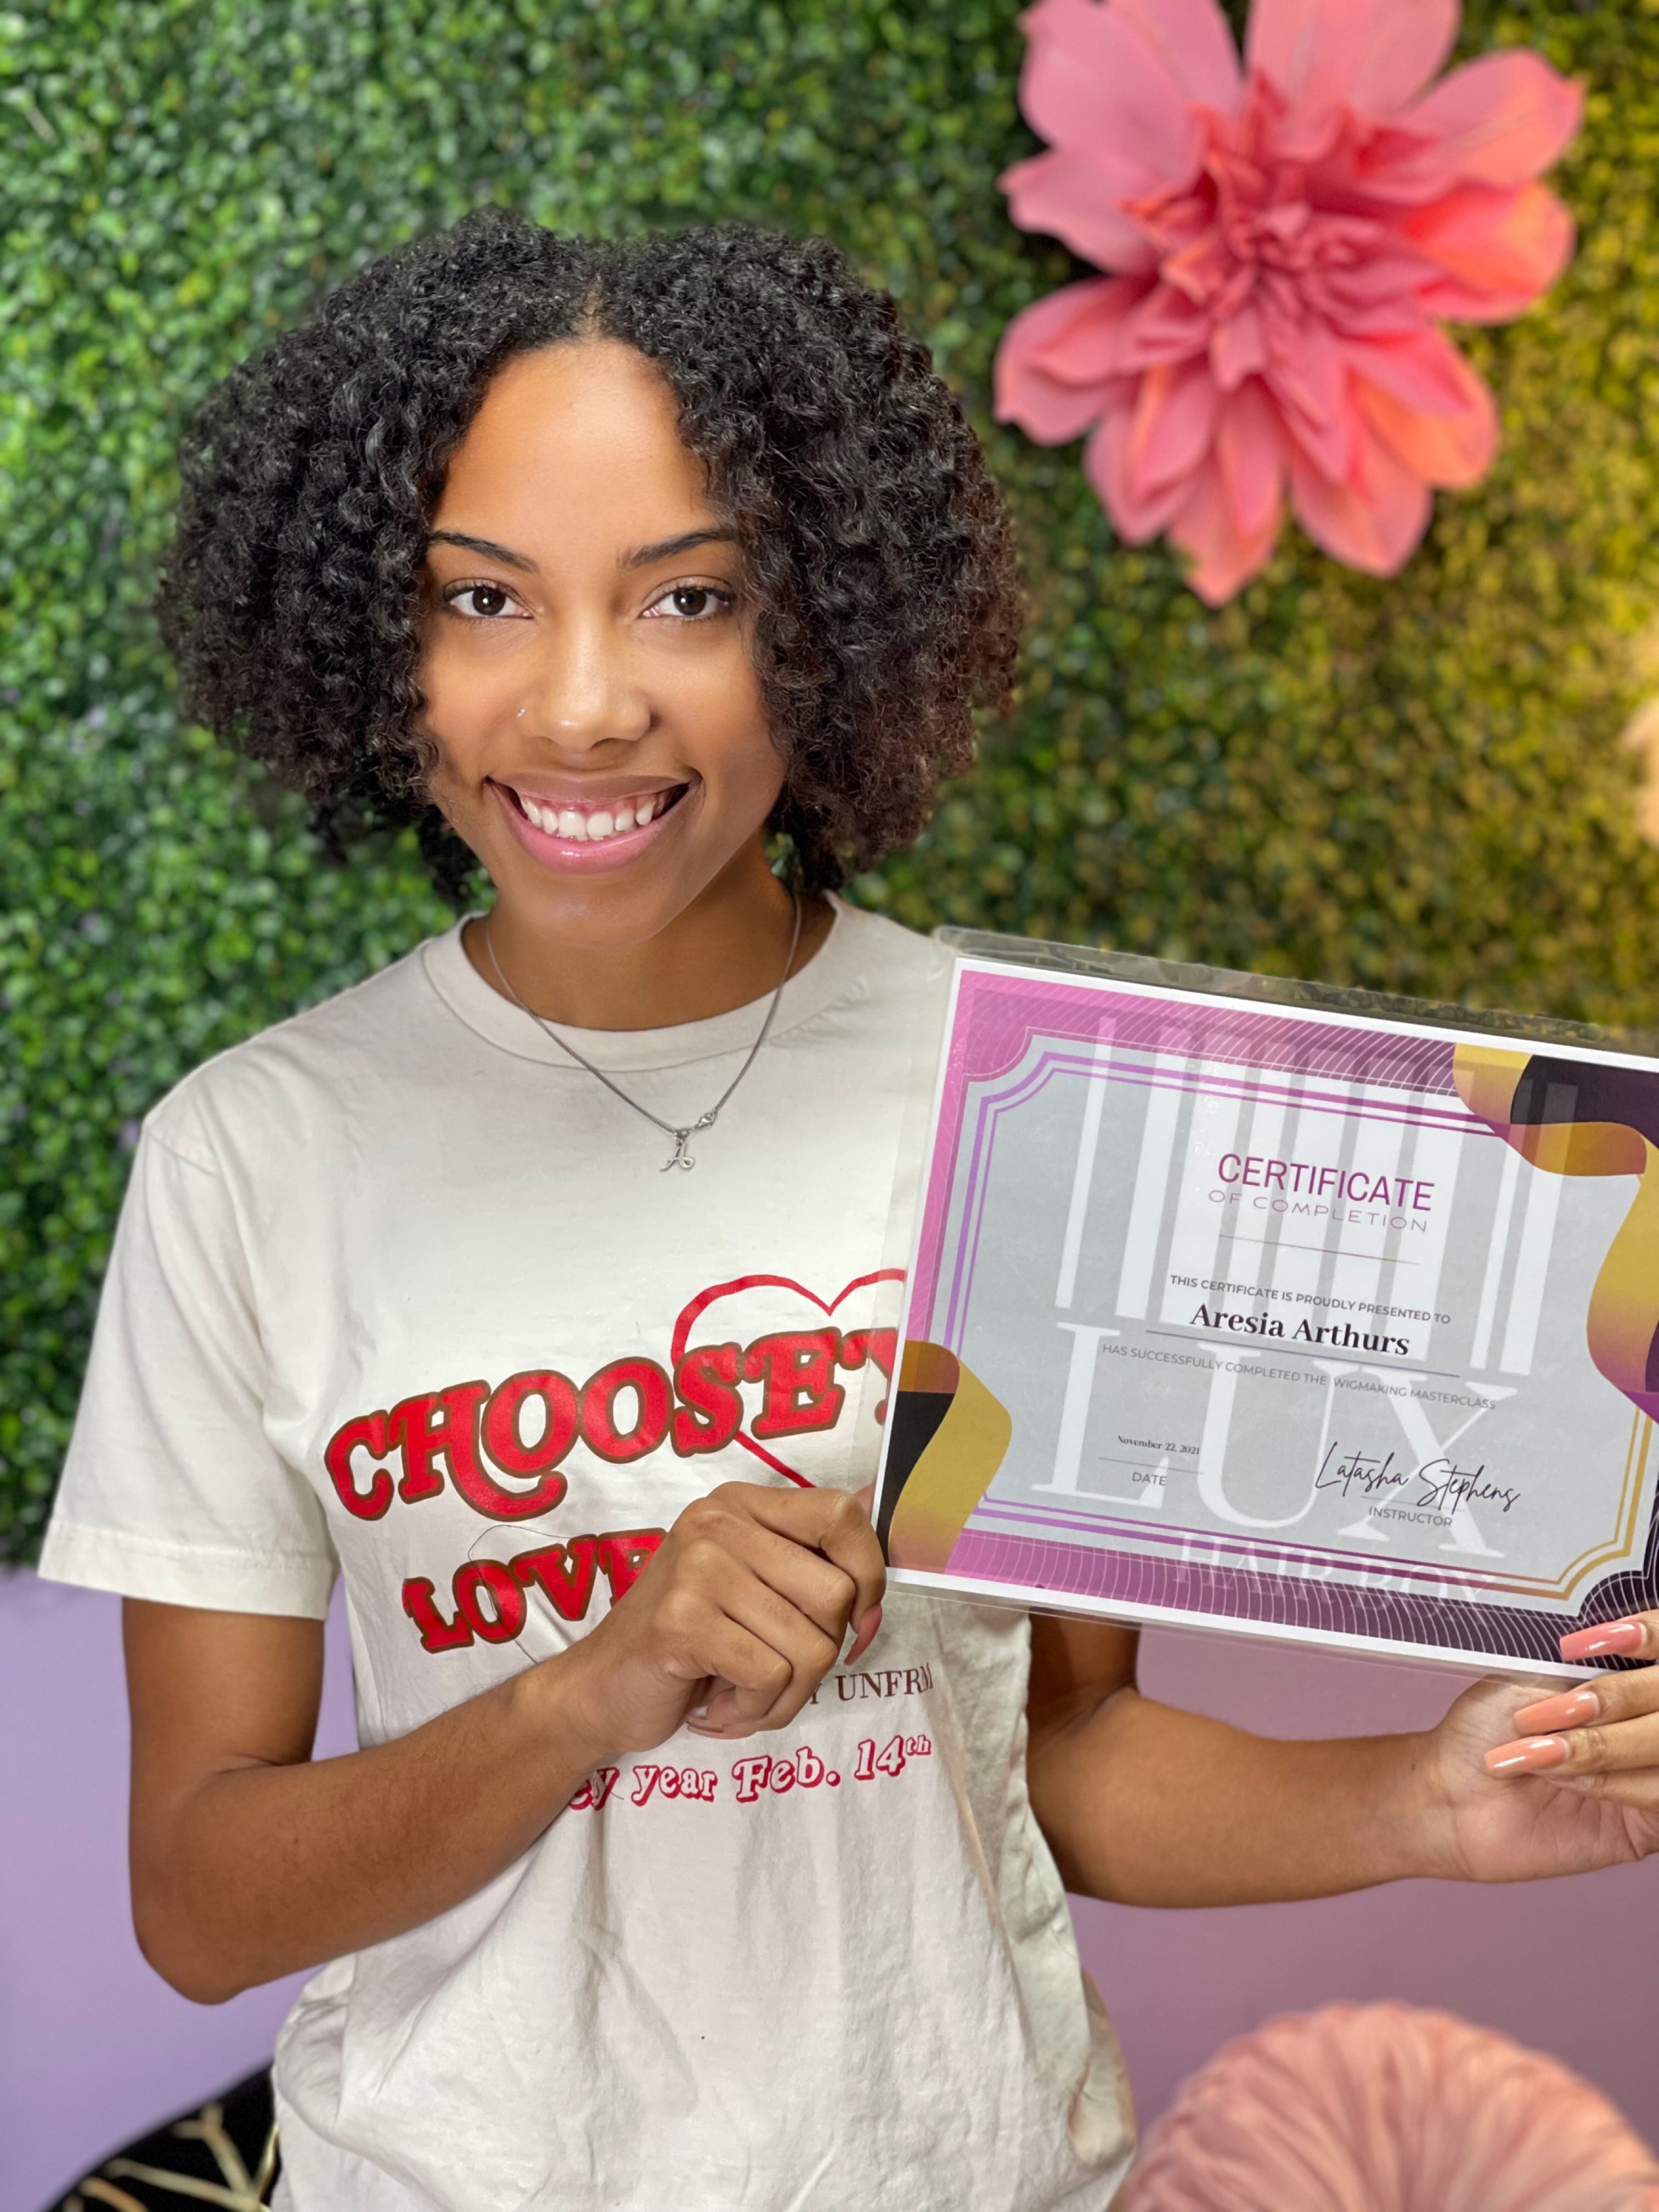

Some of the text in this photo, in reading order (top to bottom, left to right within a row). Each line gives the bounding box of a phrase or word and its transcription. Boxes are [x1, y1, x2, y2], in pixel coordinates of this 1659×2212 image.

[1218, 1153, 1435, 1211] CERTIFICATE
[1209, 1189, 1427, 1233] OF COMPLETION
[1170, 1274, 1451, 1325] THIS CERTIFICATE IS PROUDLY PRESENTED TO
[1189, 1304, 1410, 1356] Aresia Arthurs
[1102, 1344, 1497, 1410] HAS SUCCESSFULLY COMPLETED THE WIGMAKING MASTERCLASS
[1118, 1435, 1163, 1450] November
[1180, 1444, 1200, 1455] 2021
[1132, 1471, 1167, 1487] DATE
[1315, 1441, 1520, 1515] Latasha Stephens
[1368, 1506, 1453, 1527] INSTRUCTOR
[631, 1765, 718, 1807] year
[732, 1746, 841, 1803] Feb.
[854, 1733, 932, 1781] 14th
